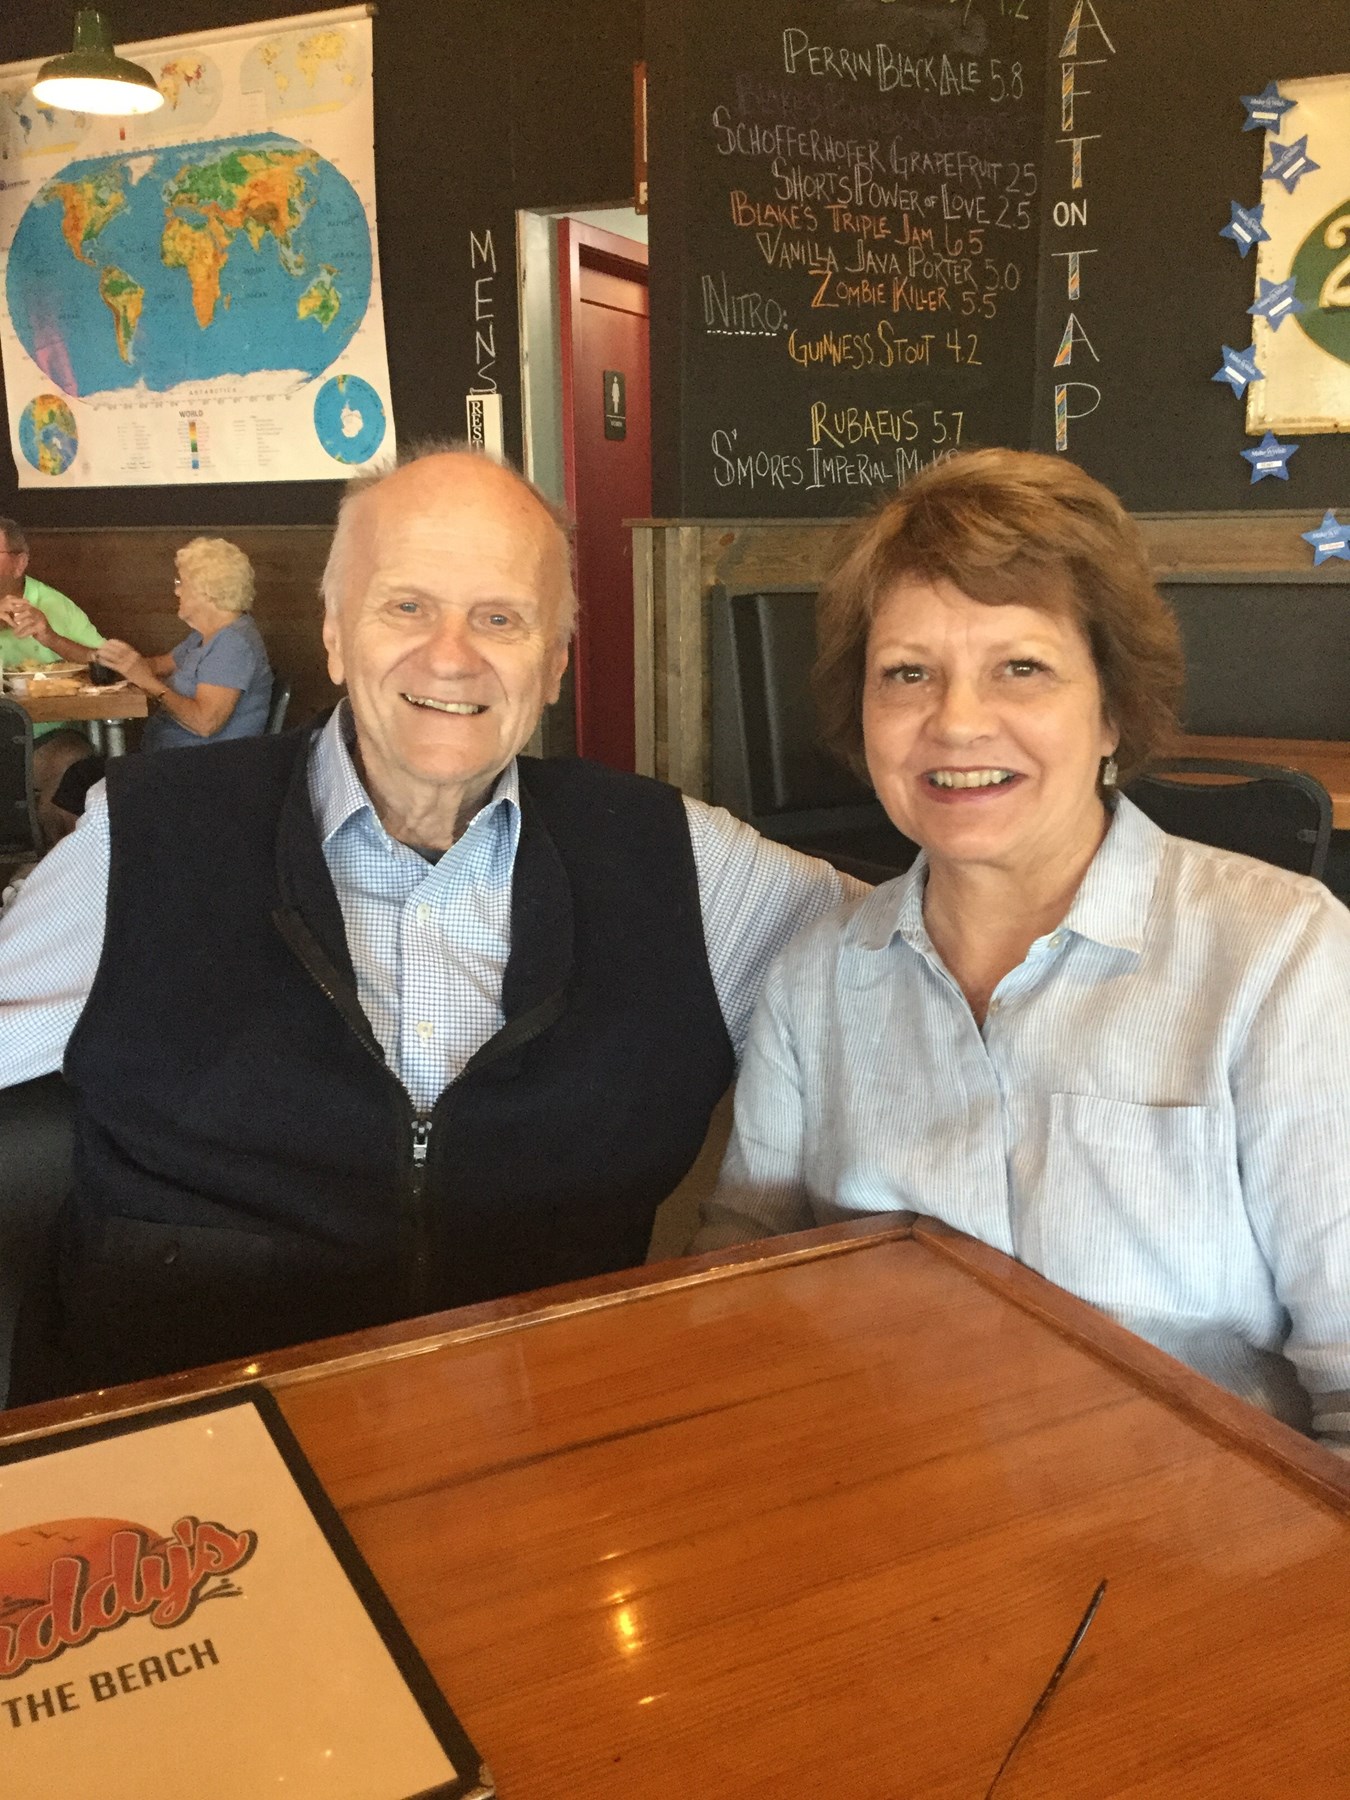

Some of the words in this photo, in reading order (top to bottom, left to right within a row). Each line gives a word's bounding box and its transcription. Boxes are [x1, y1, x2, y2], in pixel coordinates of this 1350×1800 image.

[940, 53, 982, 96] ALE
[824, 204, 892, 240] TRIPLE
[894, 212, 935, 250] JAM
[941, 183, 991, 224] LOVE
[1053, 199, 1087, 227] ON
[756, 224, 839, 273] VANILLA
[844, 239, 902, 274] JAVA
[908, 246, 979, 293] PORTER
[469, 229, 497, 395] MENS
[808, 269, 886, 308] ZOMBIE
[892, 276, 952, 313] KILLER
[961, 290, 998, 319] 5.5
[788, 328, 875, 370] GUINNESS
[877, 320, 935, 368] STOUT
[178, 409, 204, 419] WORLD
[810, 401, 919, 449] RUBAEUS
[932, 410, 964, 445] 5.7
[0, 1680, 81, 1729] THE
[88, 1637, 220, 1703] BEACH
